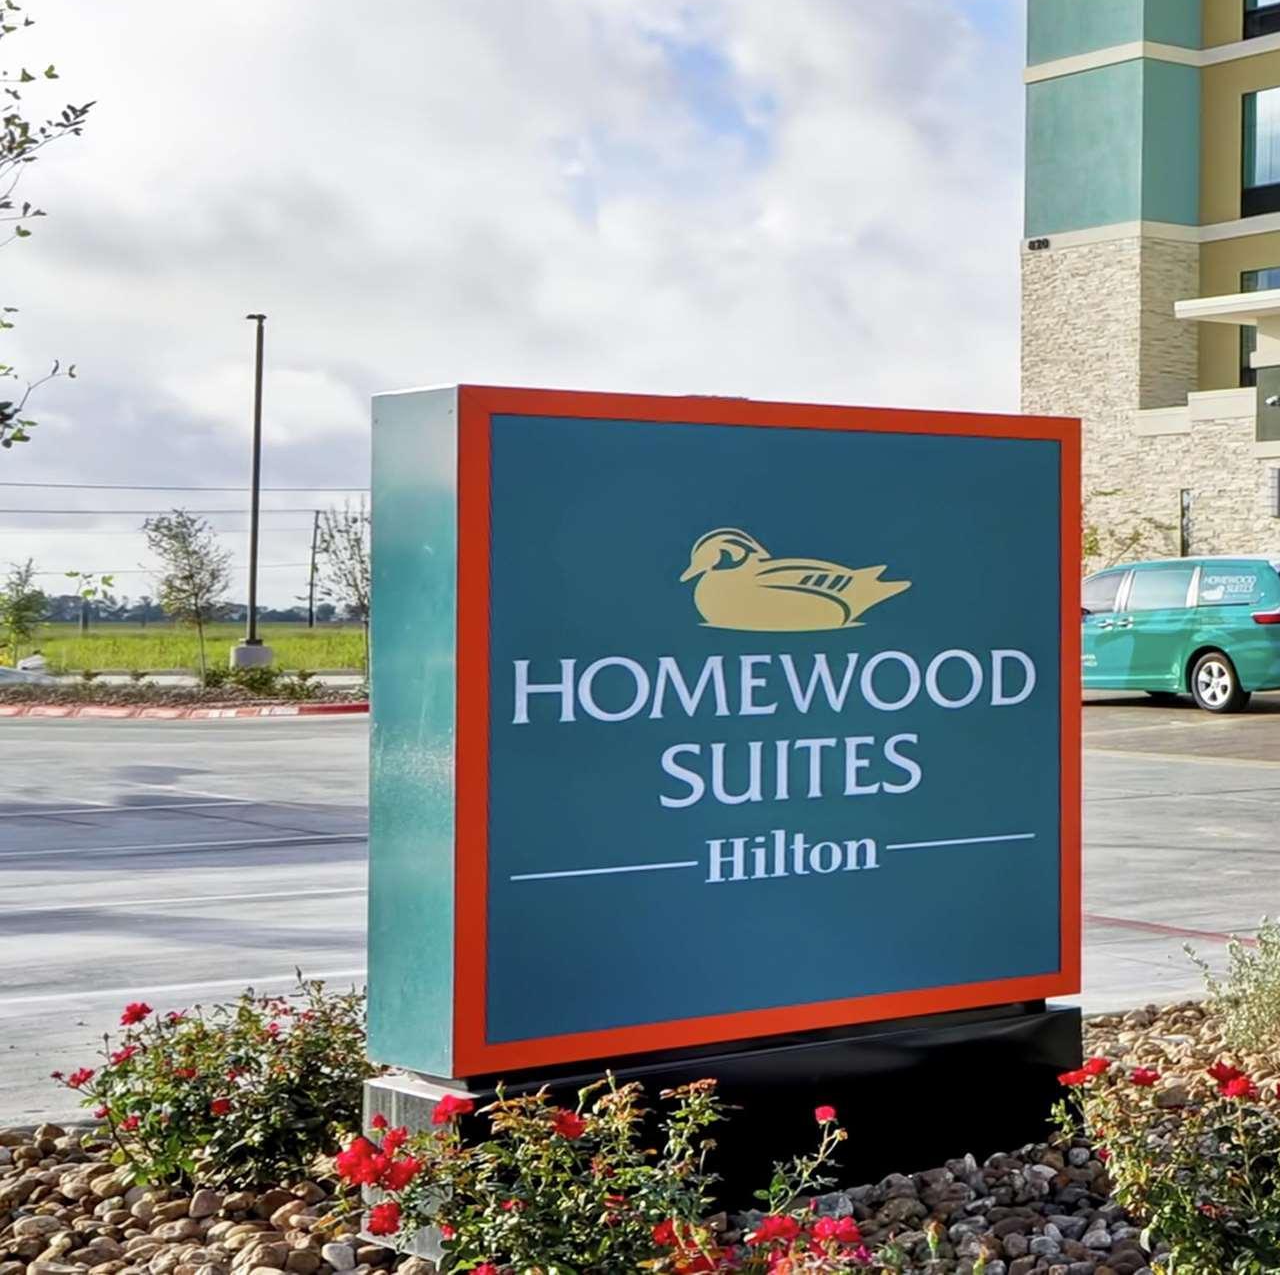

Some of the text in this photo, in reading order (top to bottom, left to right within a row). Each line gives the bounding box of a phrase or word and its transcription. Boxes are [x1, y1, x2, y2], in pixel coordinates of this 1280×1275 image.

[511, 648, 1037, 725] HOMEWOOD
[659, 733, 923, 809] SUITES
[704, 829, 880, 883] Hilton
